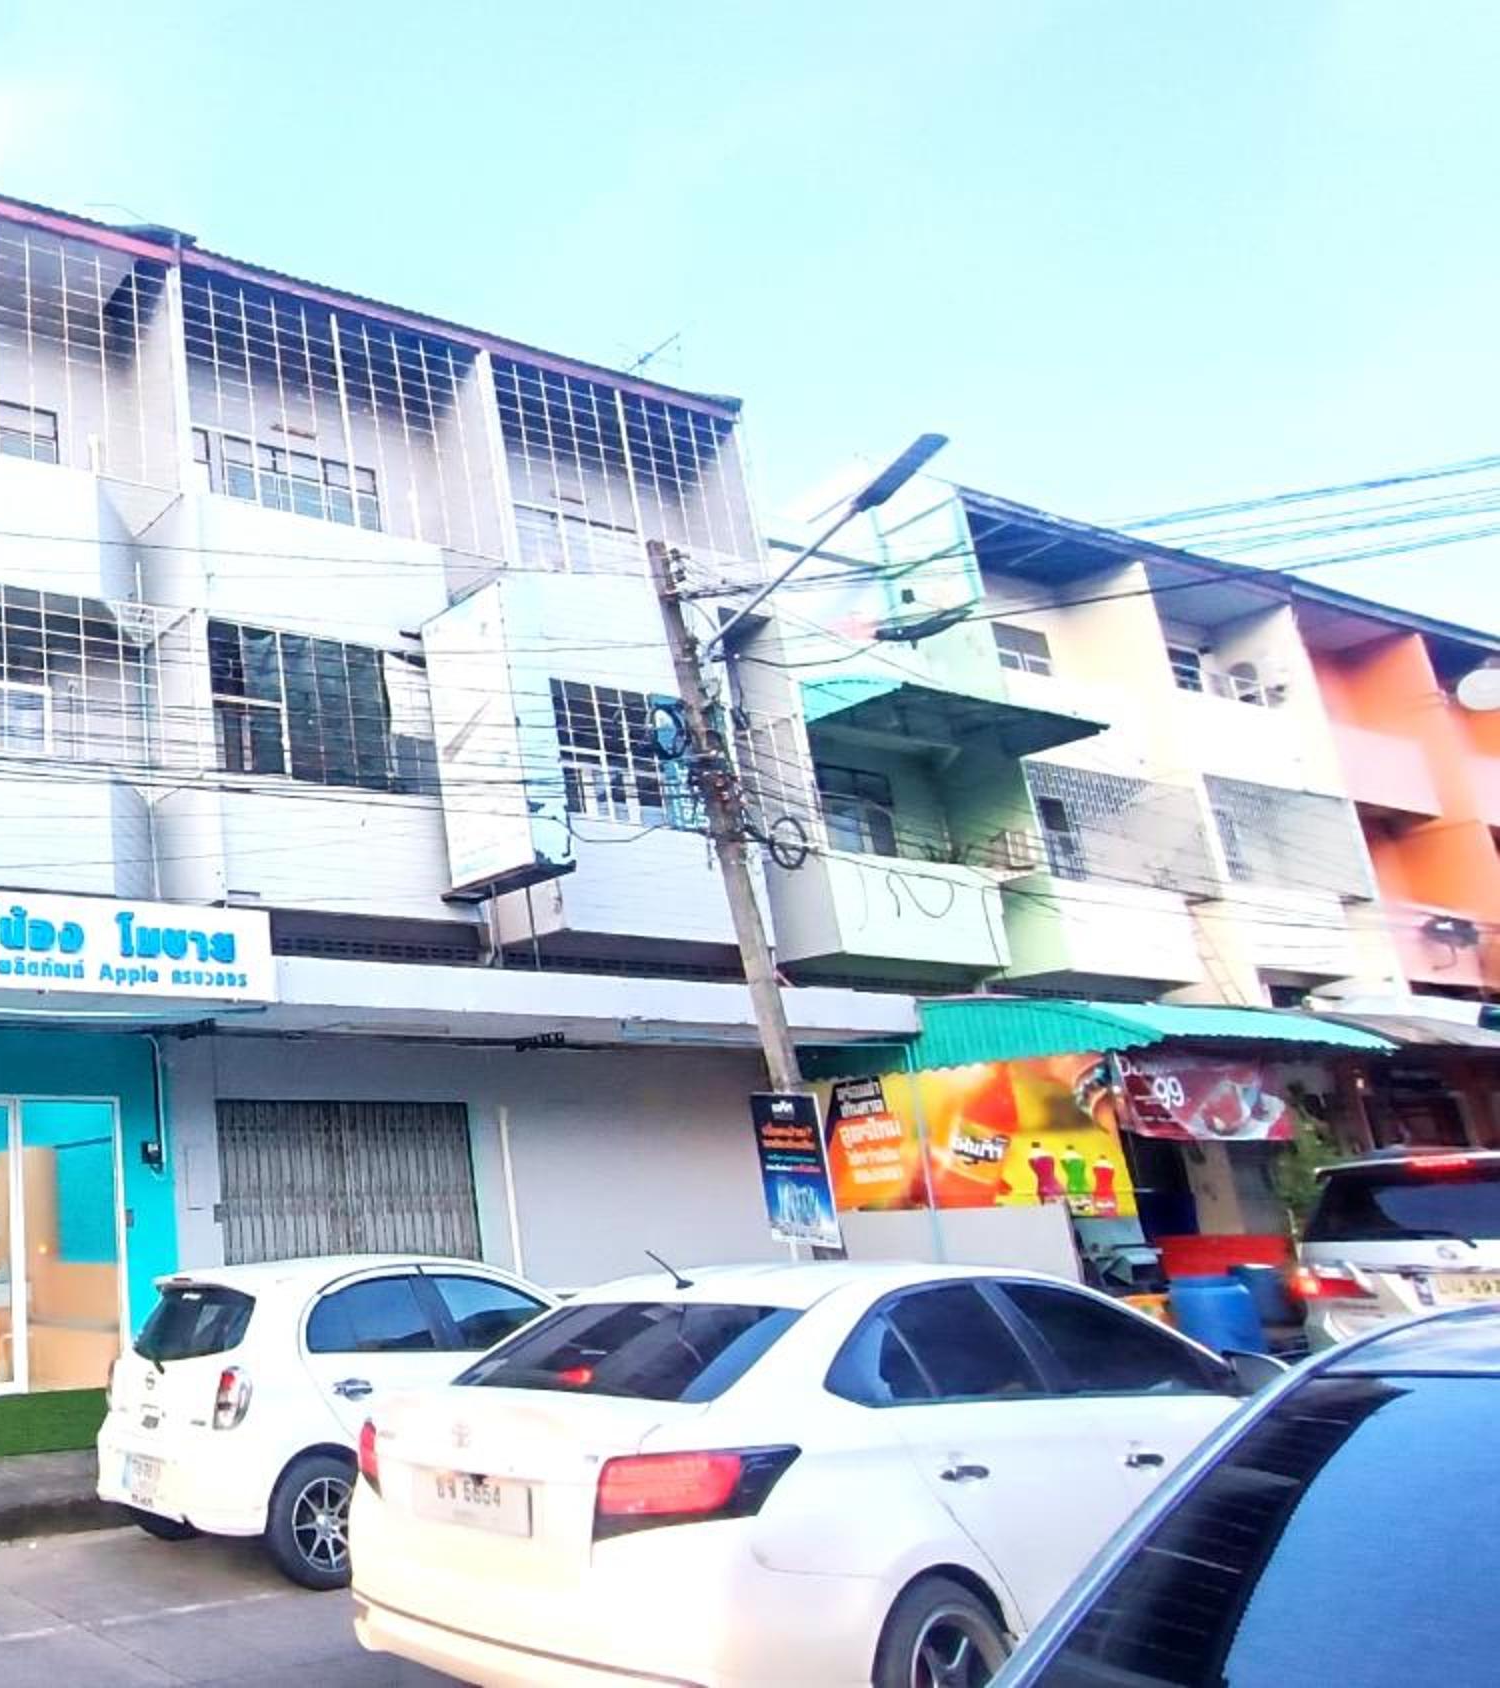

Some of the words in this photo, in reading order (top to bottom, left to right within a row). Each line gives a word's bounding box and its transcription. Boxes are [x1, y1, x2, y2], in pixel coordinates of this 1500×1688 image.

[115, 911, 236, 964] โมบาย
[99, 963, 159, 986] Apple
[171, 968, 248, 988] ครบวงจร
[1153, 1075, 1185, 1110] 99
